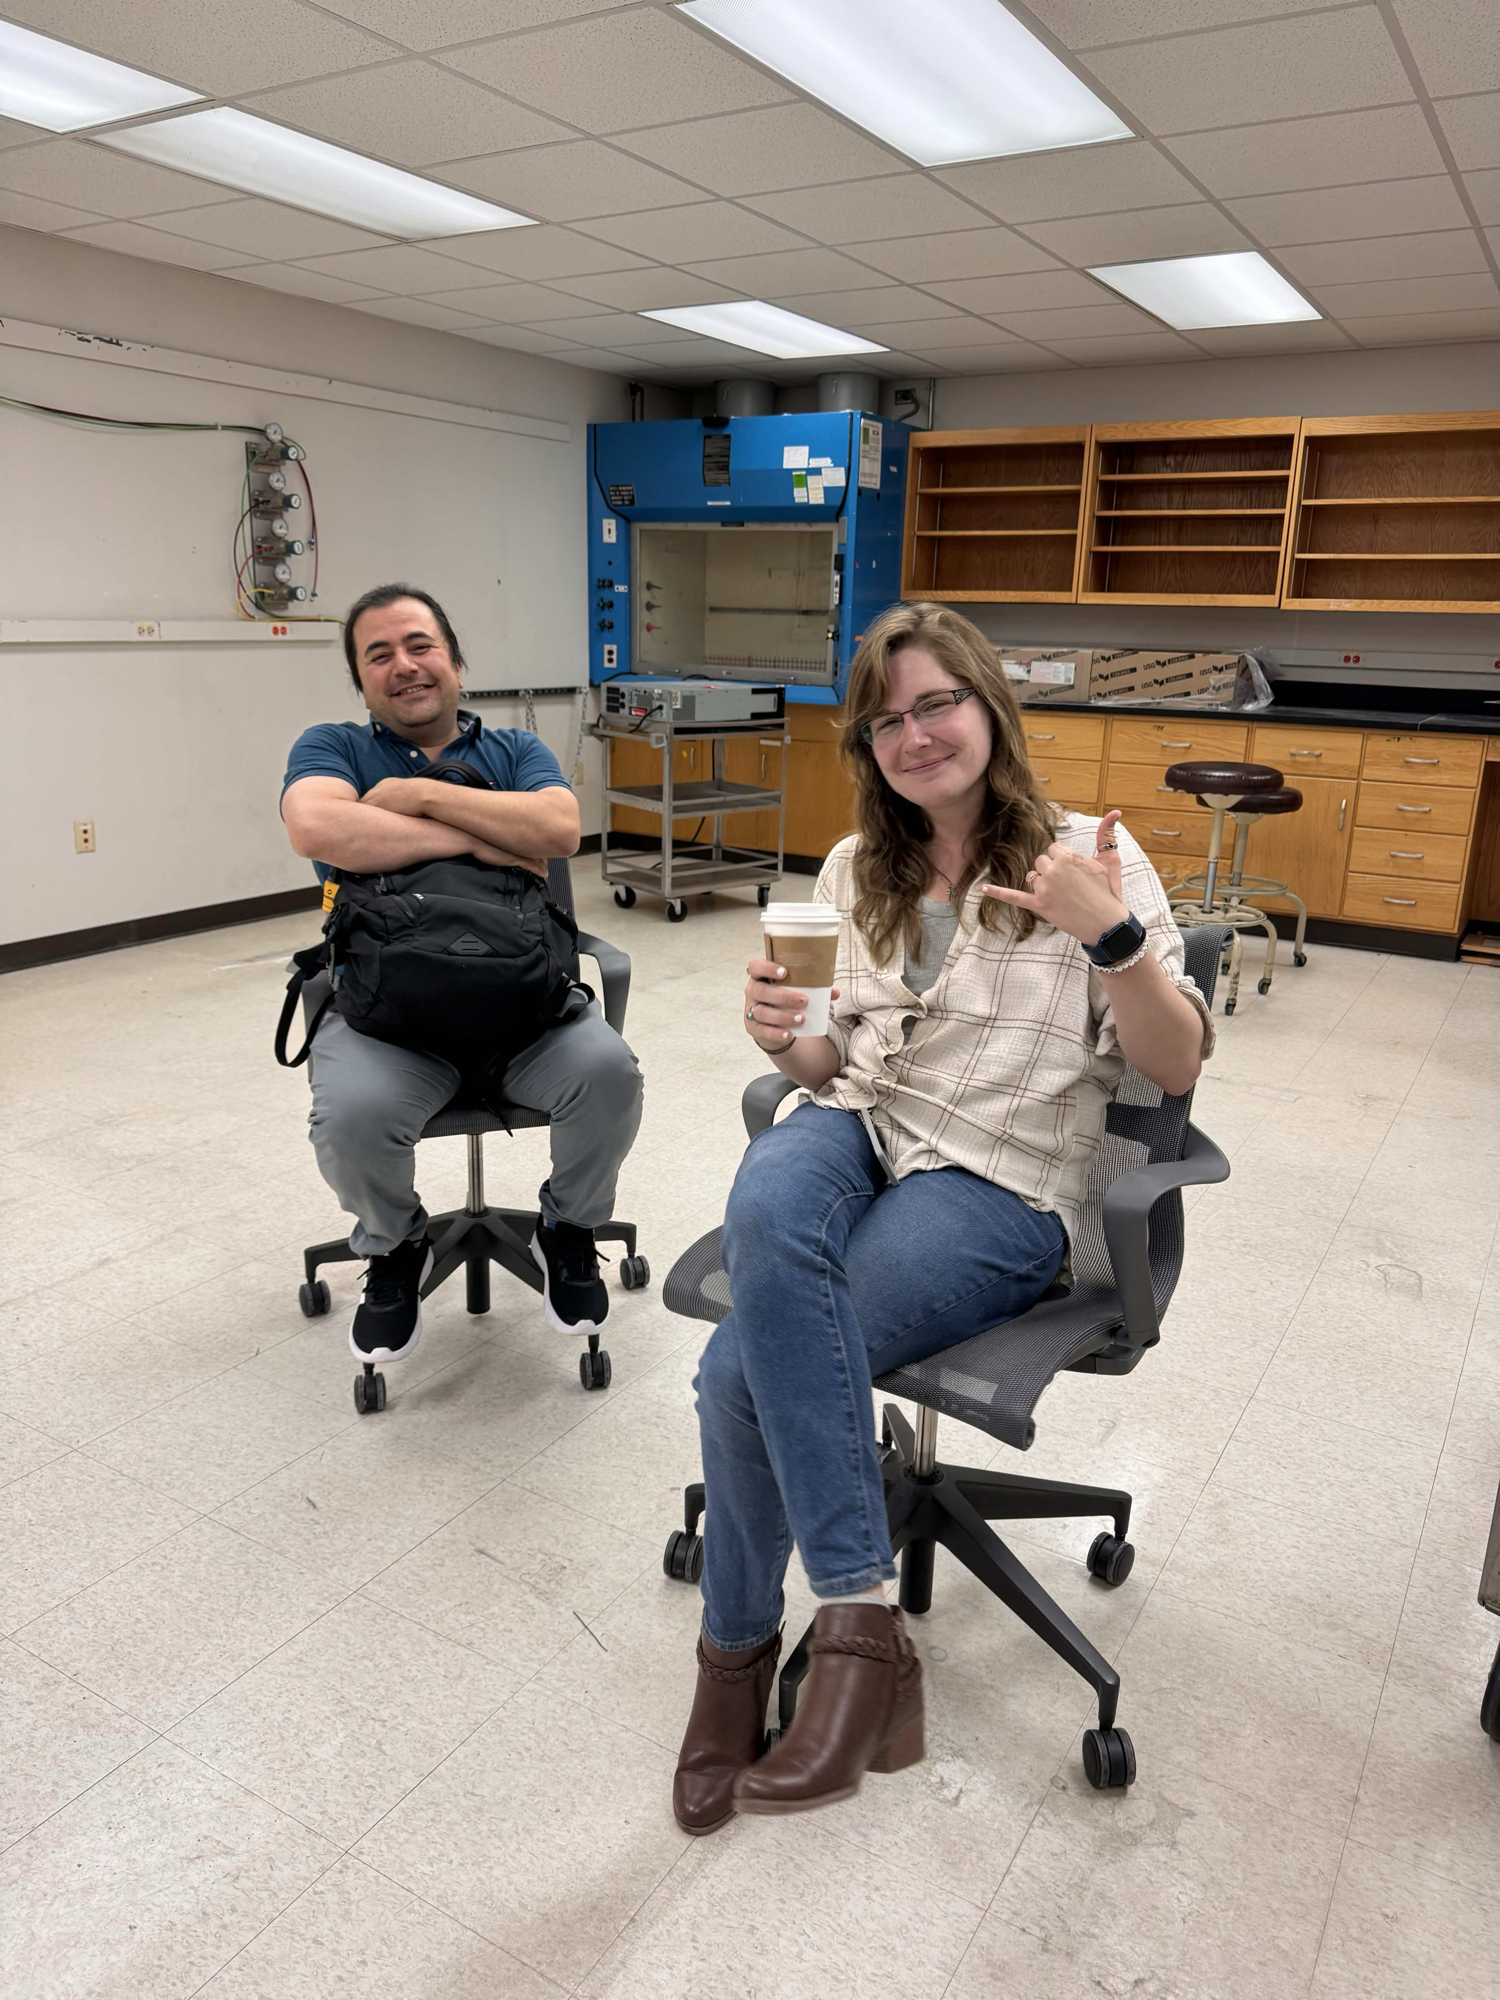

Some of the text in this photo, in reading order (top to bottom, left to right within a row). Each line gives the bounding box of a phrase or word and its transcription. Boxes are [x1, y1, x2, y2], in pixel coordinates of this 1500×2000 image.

[1143, 662, 1156, 670] USG
[1199, 667, 1213, 676] USG
[1141, 680, 1154, 689] USG
